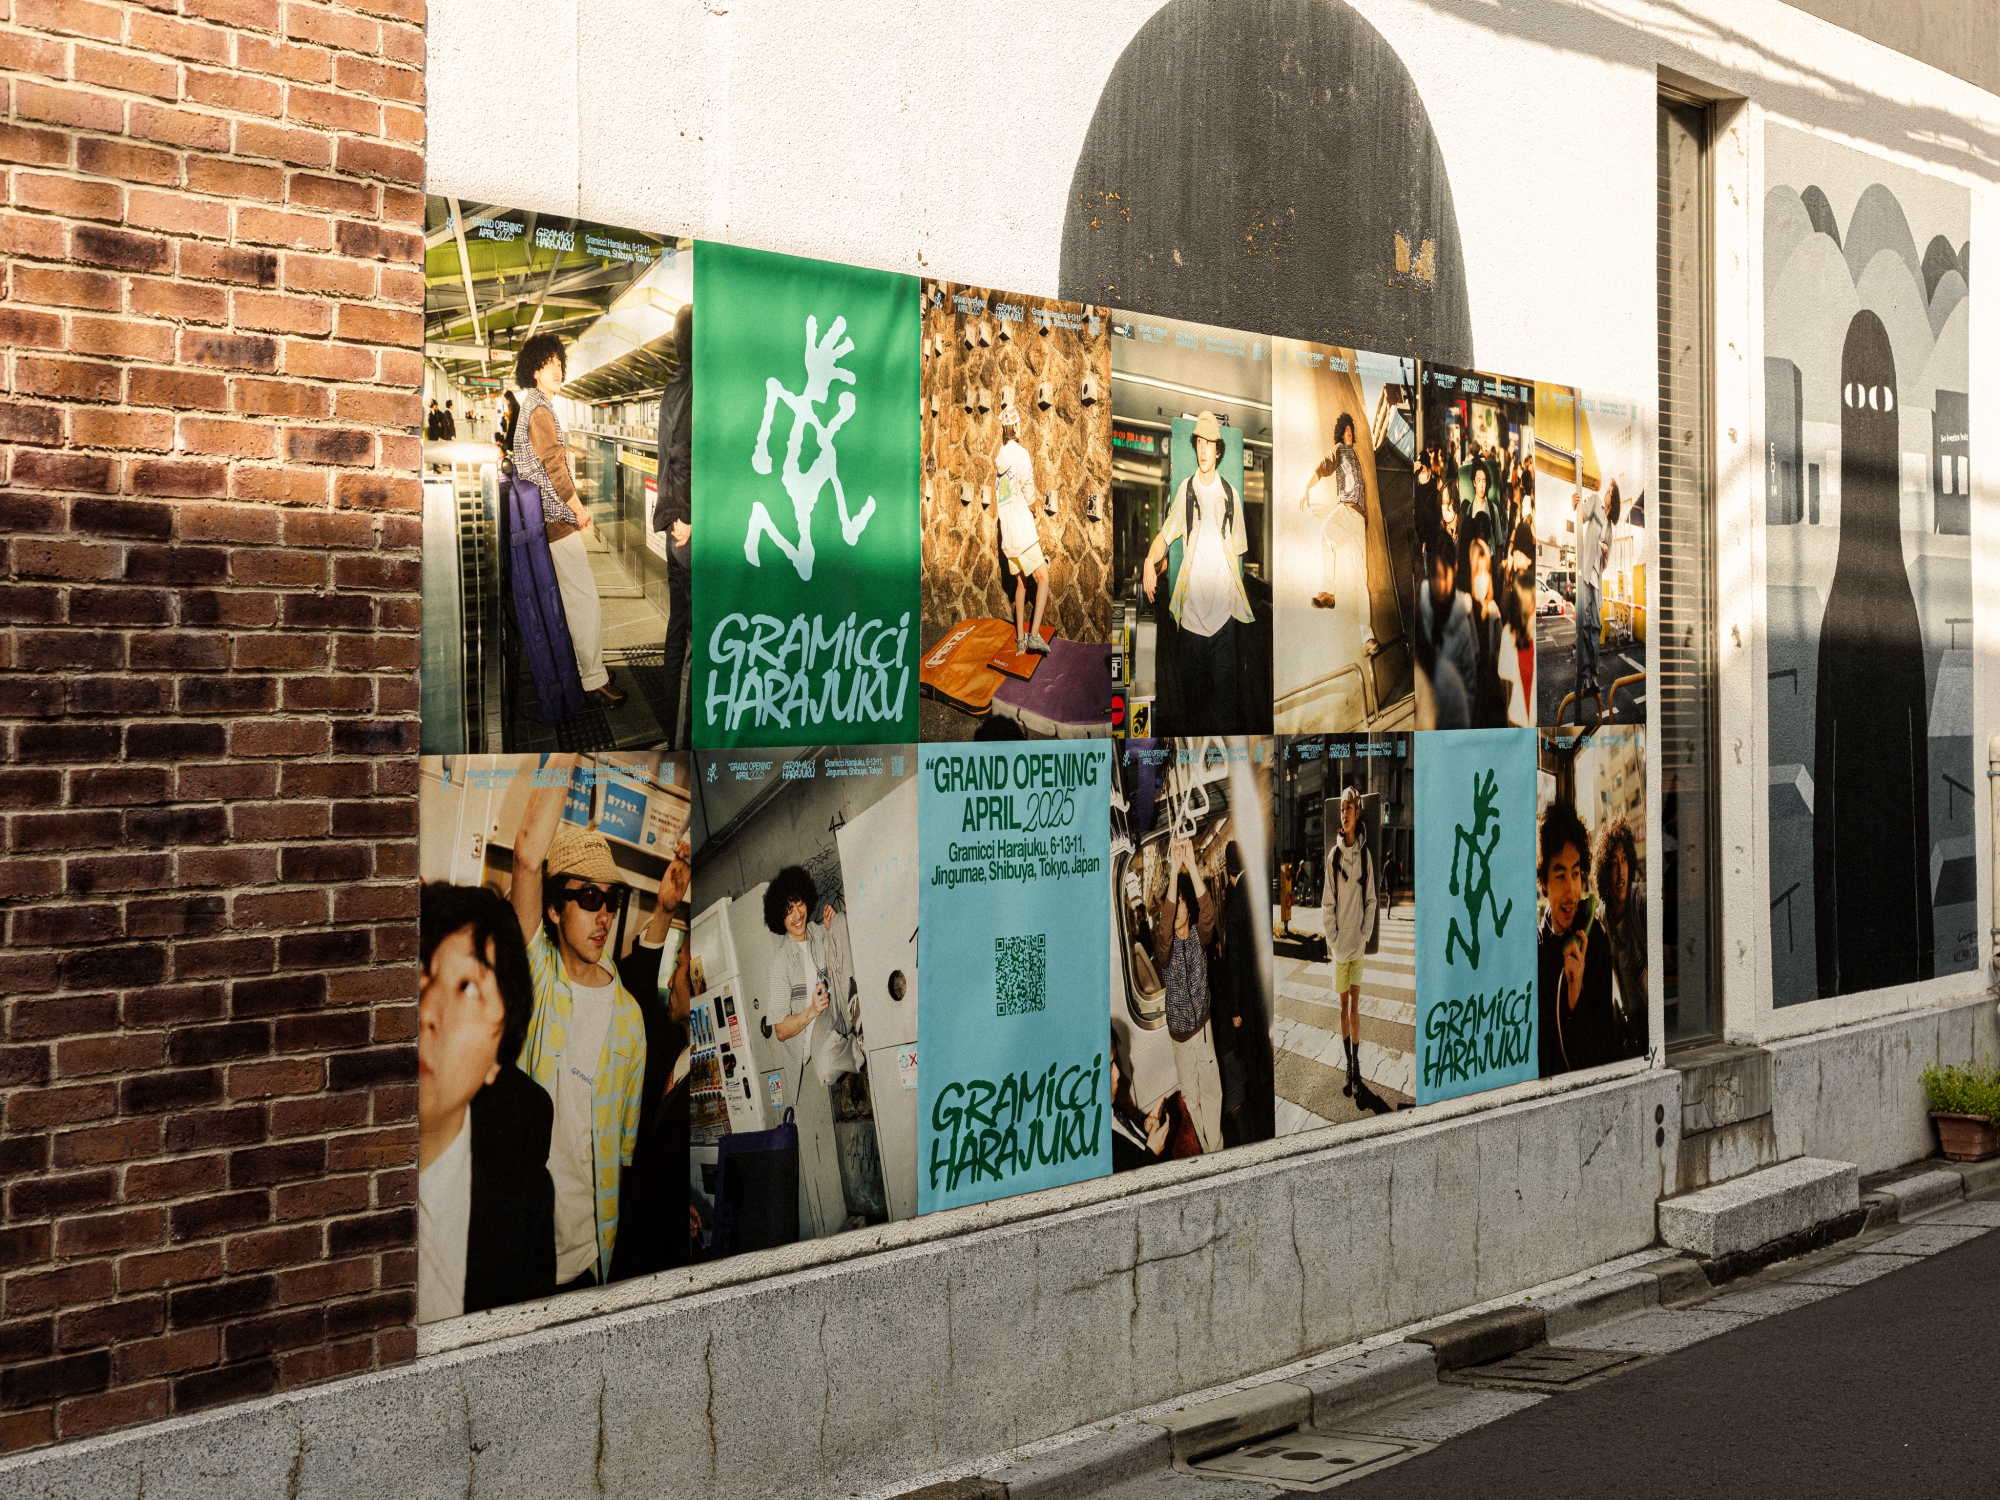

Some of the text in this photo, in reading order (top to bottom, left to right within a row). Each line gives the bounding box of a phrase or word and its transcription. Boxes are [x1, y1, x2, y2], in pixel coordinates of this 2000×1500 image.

[635, 253, 651, 265] Tokyo
[705, 666, 910, 731] HARAJUKU
[962, 786, 1076, 833] APRIL 2025
[948, 834, 1086, 862] Gramicci Harajuku, 6-13-11,
[932, 854, 1100, 890] Jingumae, Shibuya, Tokyo, Japan
[1424, 1021, 1532, 1089] HARAJUKU
[930, 1102, 1102, 1192] HARAJUKU
